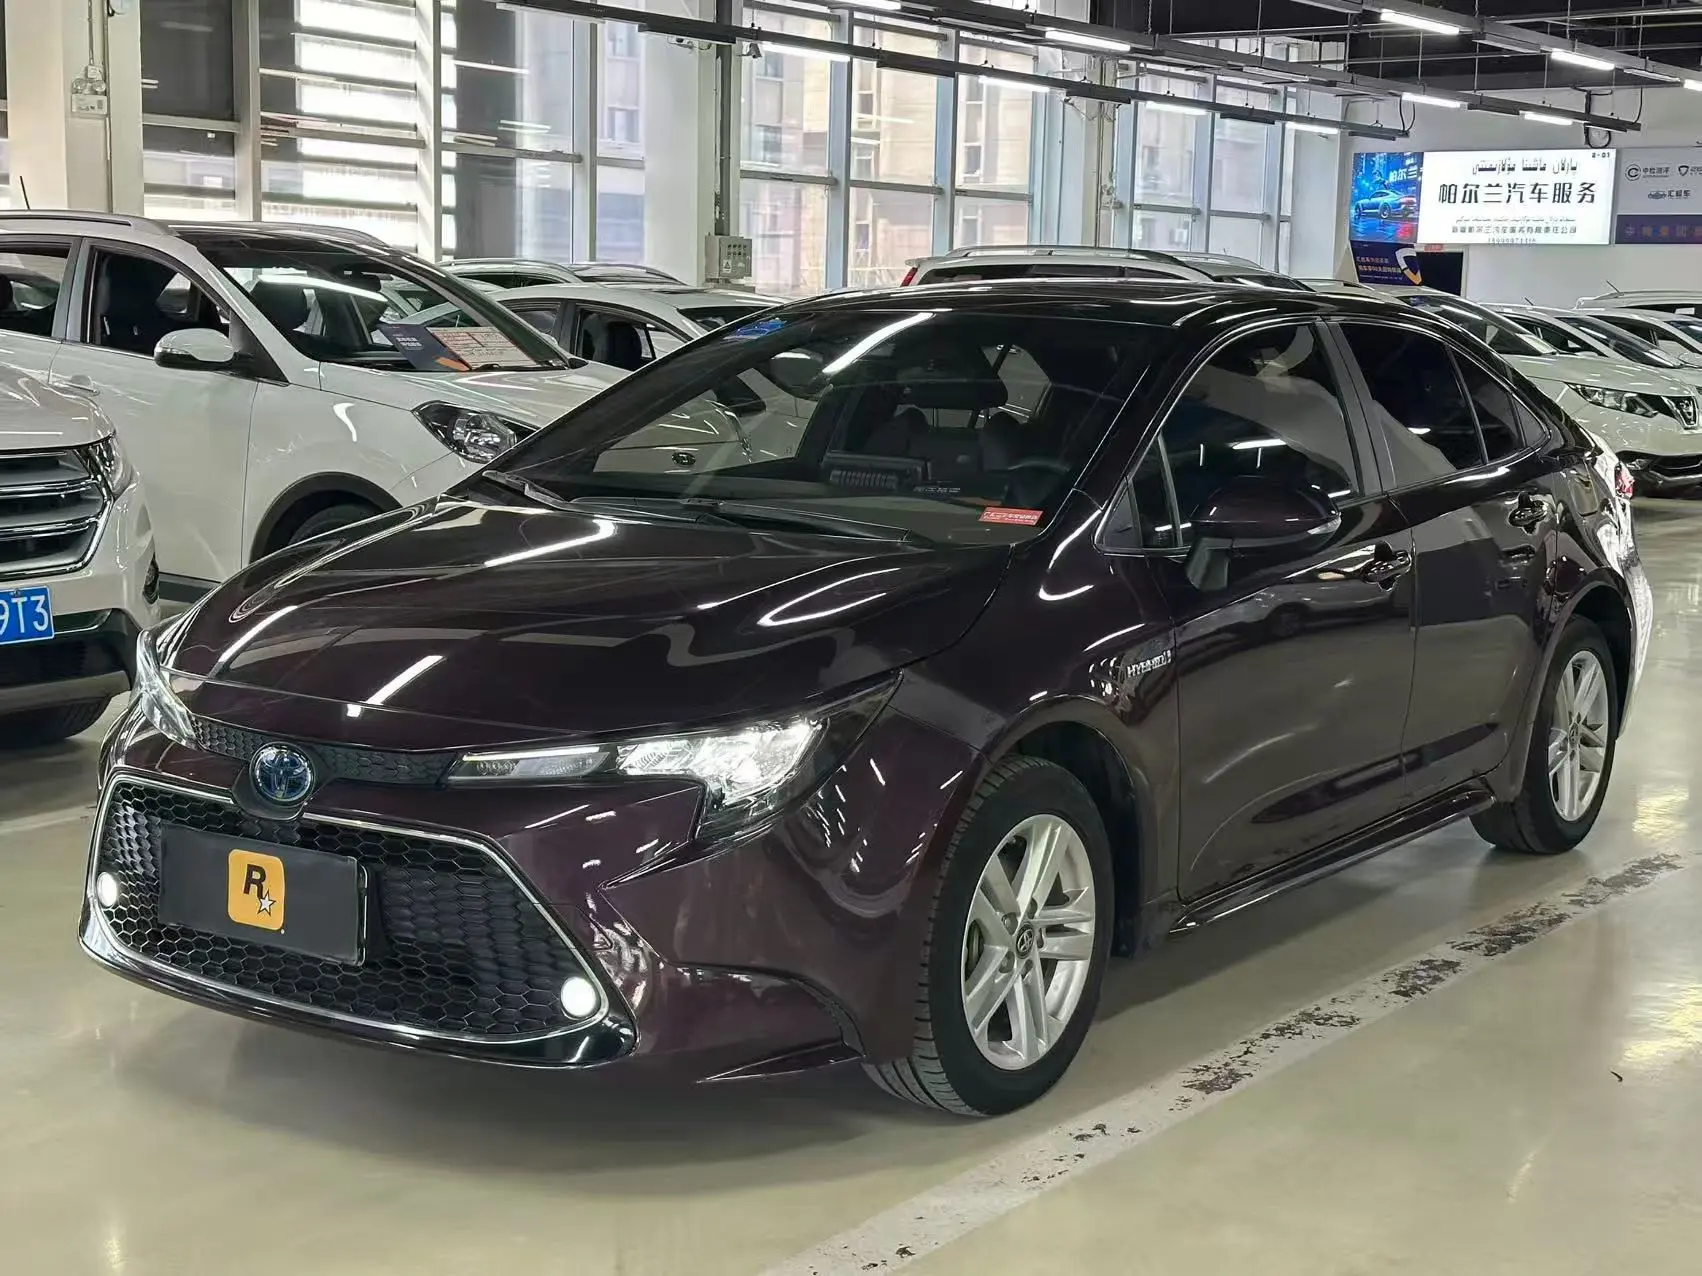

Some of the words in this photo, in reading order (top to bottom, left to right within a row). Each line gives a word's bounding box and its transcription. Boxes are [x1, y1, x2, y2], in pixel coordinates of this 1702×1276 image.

[1438, 182, 1596, 204] 帕尔兰汽车服务
[243, 864, 267, 900] R
